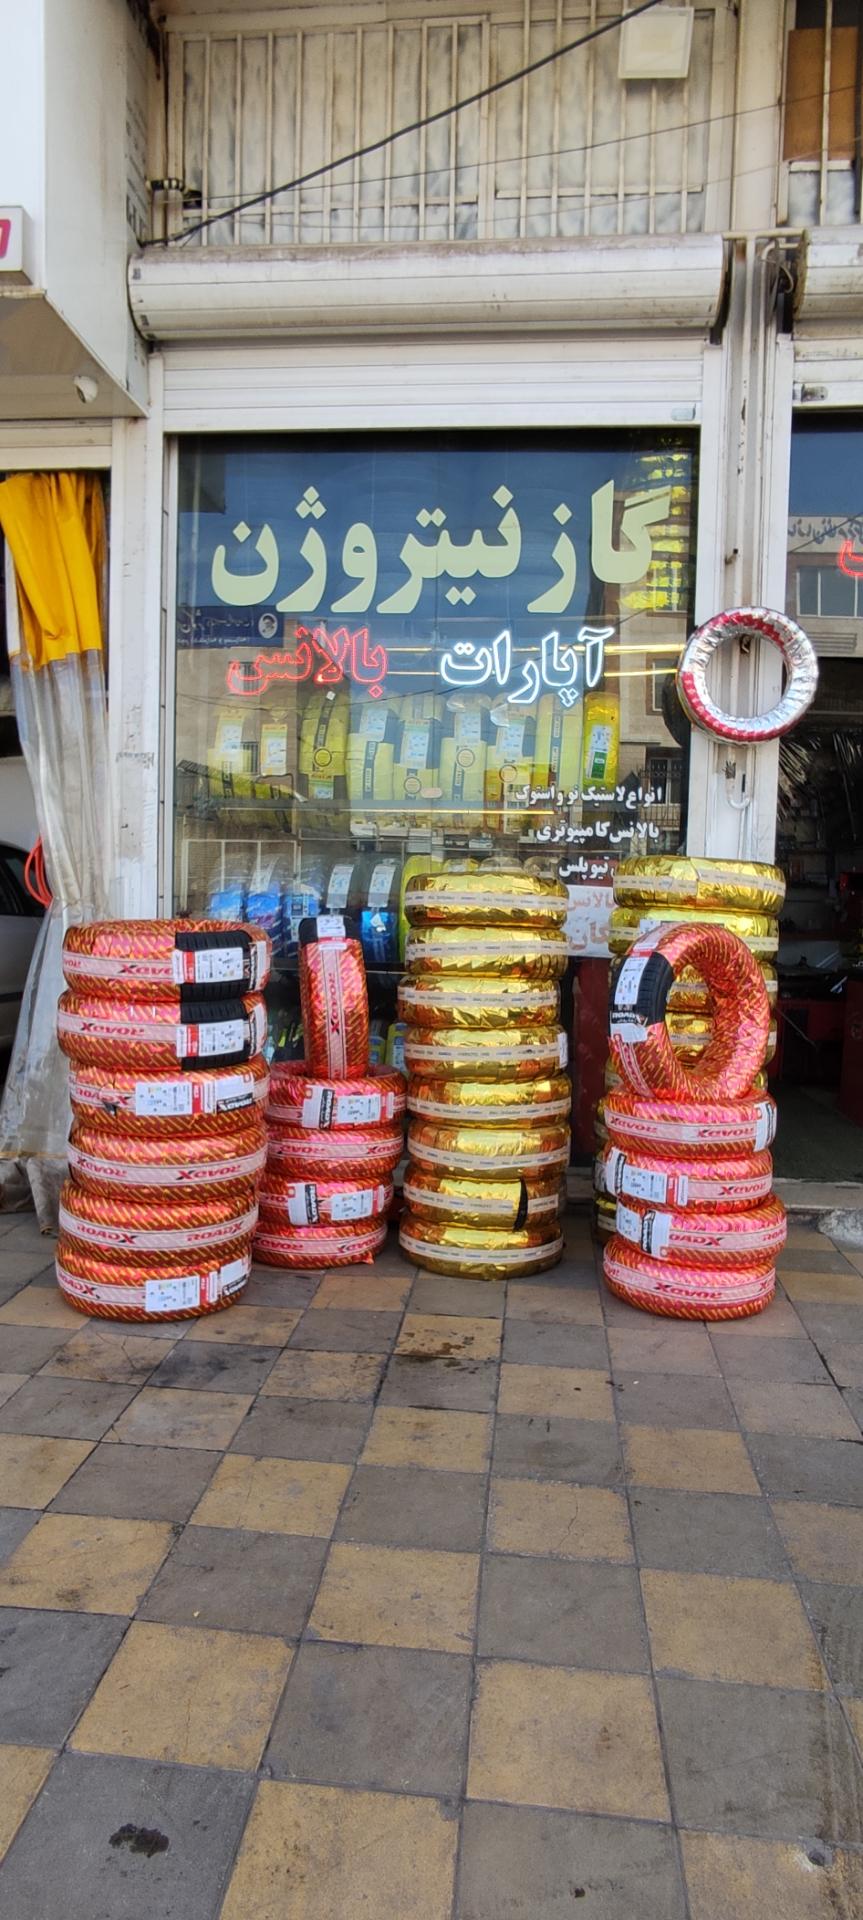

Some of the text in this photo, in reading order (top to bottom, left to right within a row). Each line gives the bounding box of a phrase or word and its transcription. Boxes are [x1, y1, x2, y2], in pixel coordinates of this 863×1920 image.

[211, 480, 672, 613] گاز نیتروژن
[225, 626, 389, 698] بالانس
[439, 625, 616, 708] آپارات
[515, 784, 663, 809] انواع لاستیک نو و استوک
[536, 819, 660, 845] بالانس کامپیوتری
[80, 1021, 145, 1037] ROADX
[696, 1127, 755, 1139] ROADX
[77, 1155, 128, 1178] ROADX
[176, 1164, 242, 1181] ROADX
[719, 1181, 768, 1196] ROADX
[77, 1224, 138, 1245] ROADX
[187, 1221, 245, 1243] ROADX
[653, 1281, 724, 1300] ROADX
